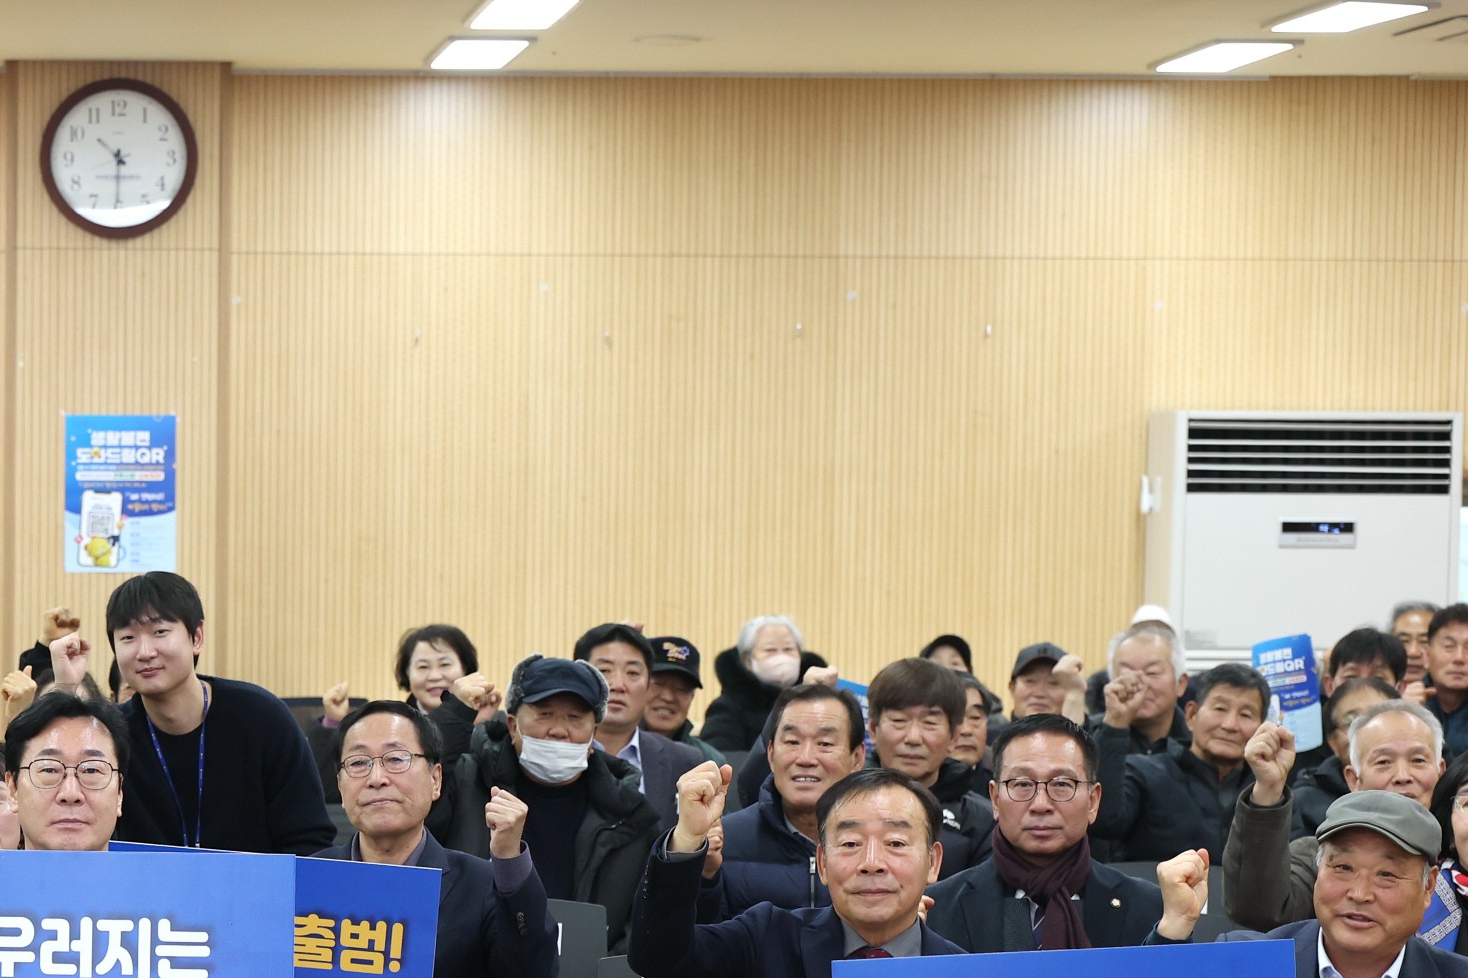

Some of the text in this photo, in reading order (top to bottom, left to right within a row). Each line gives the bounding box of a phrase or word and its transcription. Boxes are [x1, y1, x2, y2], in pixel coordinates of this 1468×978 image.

[88, 107, 100, 124] 11
[110, 100, 127, 117] 12
[142, 107, 148, 124] 1
[69, 125, 85, 142] 10
[158, 125, 169, 141] 2
[63, 151, 75, 167] 9
[166, 150, 177, 167] 3
[70, 175, 82, 191] 8
[155, 175, 166, 191] 4
[294, 914, 404, 975] 출범!
